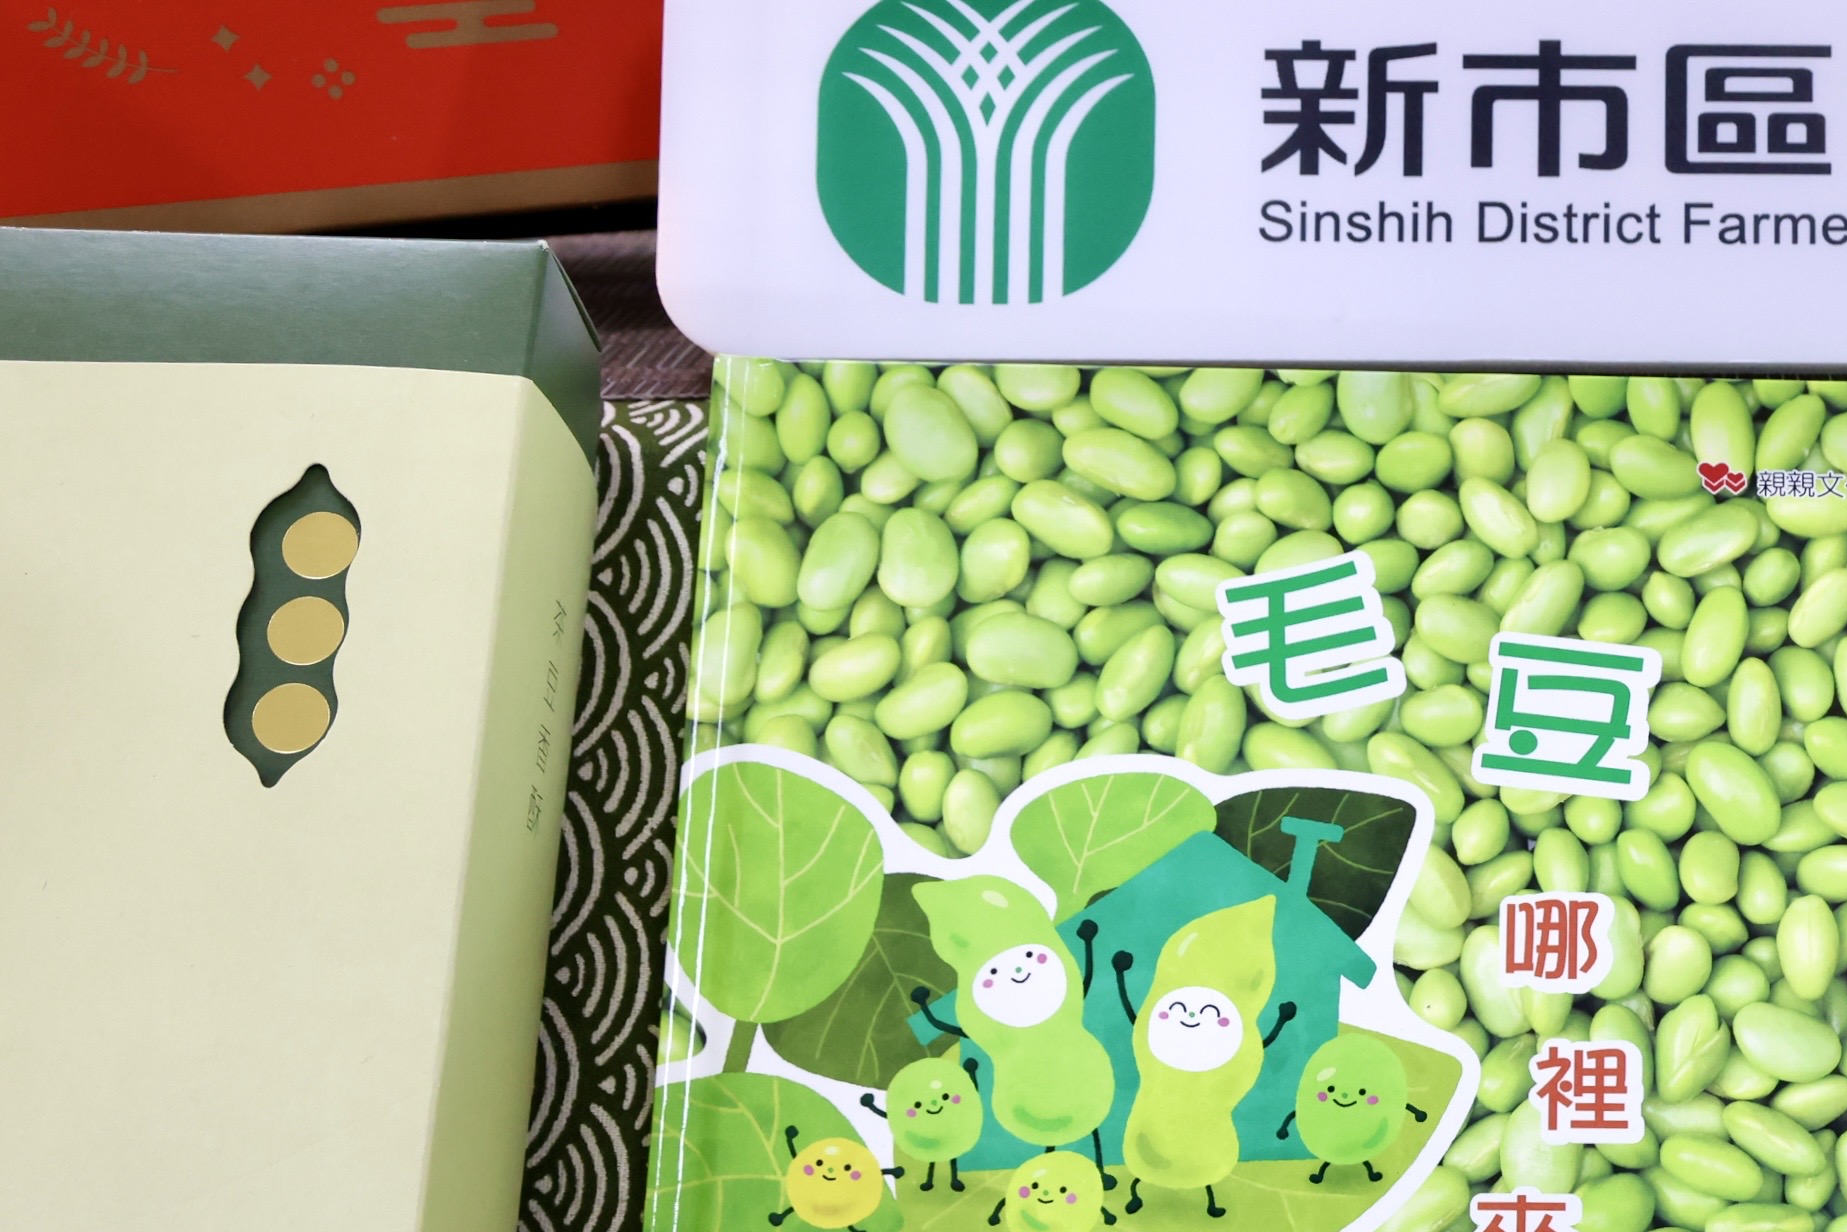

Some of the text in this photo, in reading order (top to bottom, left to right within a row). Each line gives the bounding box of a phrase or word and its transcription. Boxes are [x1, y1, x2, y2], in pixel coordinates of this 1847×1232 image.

[1259, 199, 1453, 243] Sinshih
[1477, 200, 1661, 244] District
[1226, 560, 1644, 785] 毛豆
